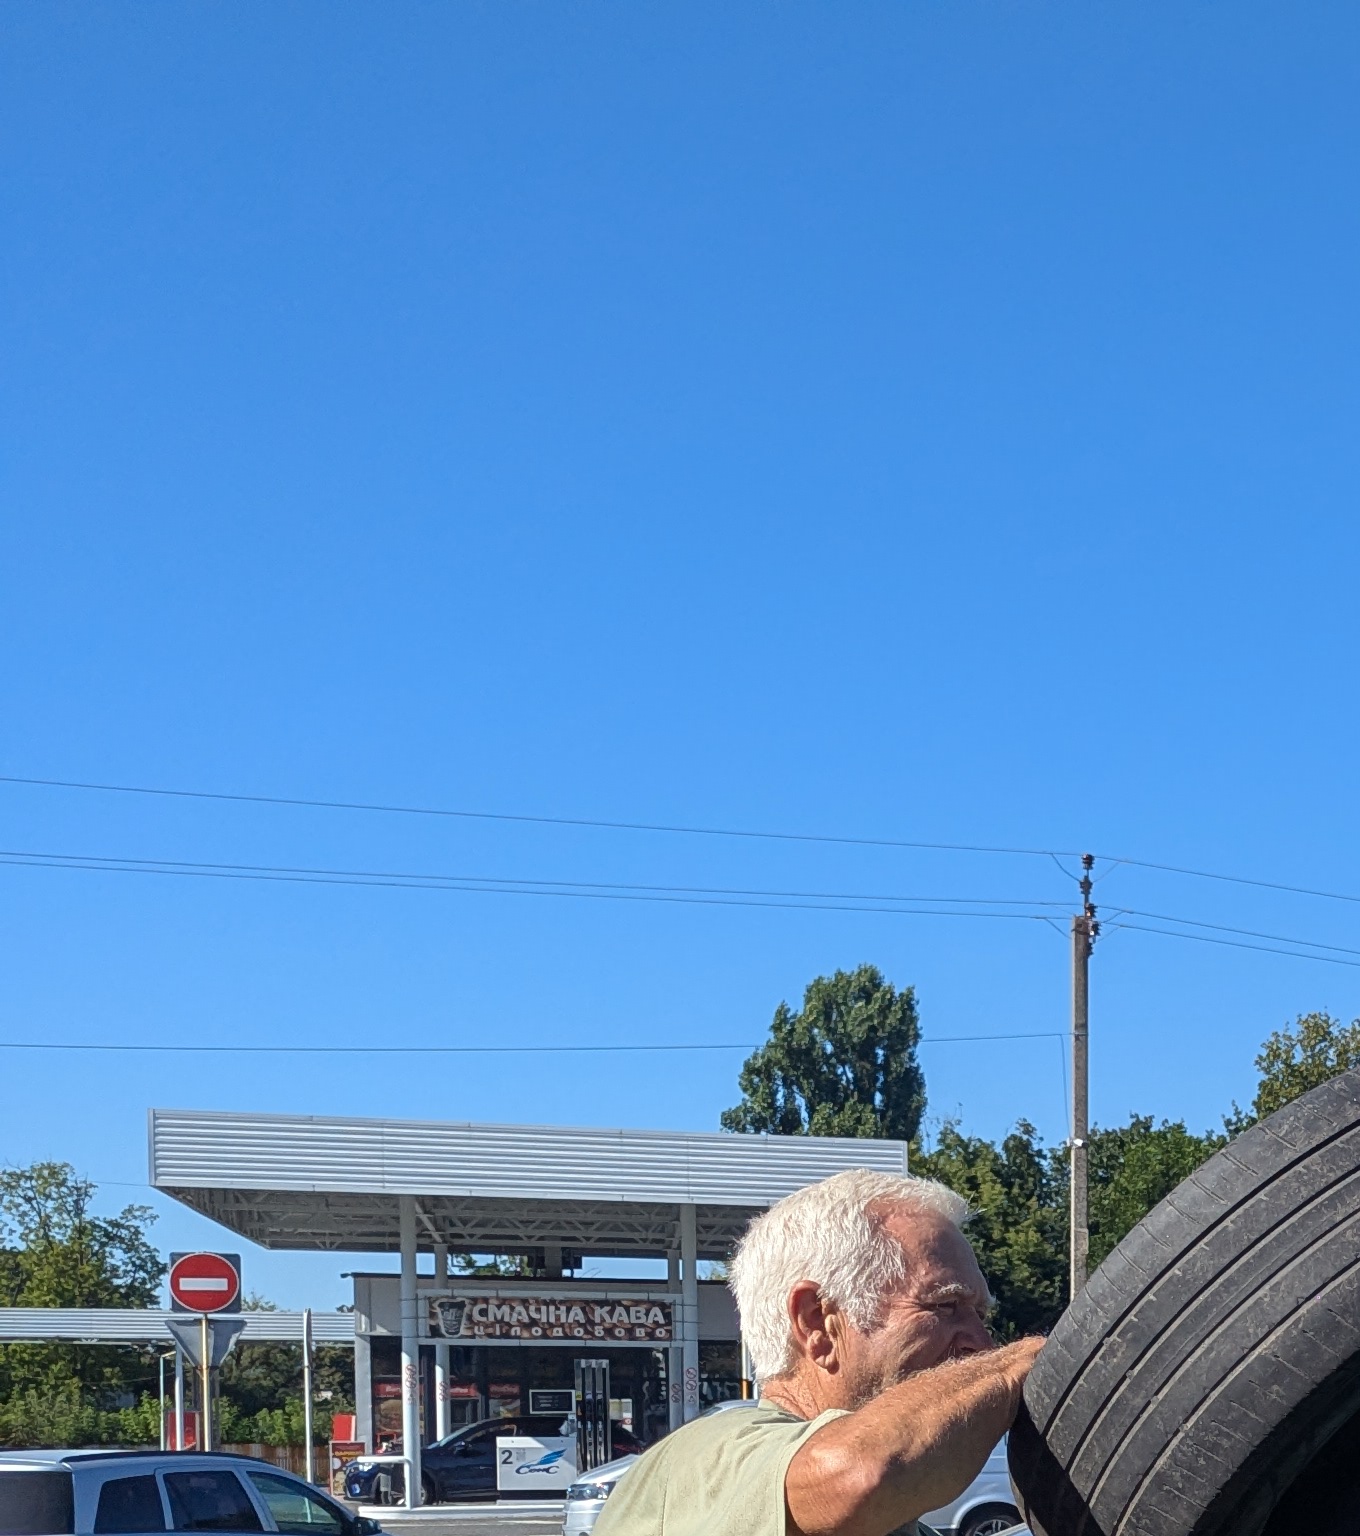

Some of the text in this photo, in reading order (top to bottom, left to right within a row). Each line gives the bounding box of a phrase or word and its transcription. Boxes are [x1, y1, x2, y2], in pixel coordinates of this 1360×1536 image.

[471, 1303, 587, 1323] СМАЧНА
[594, 1304, 667, 1325] КАВА
[501, 1449, 513, 1465] 2
